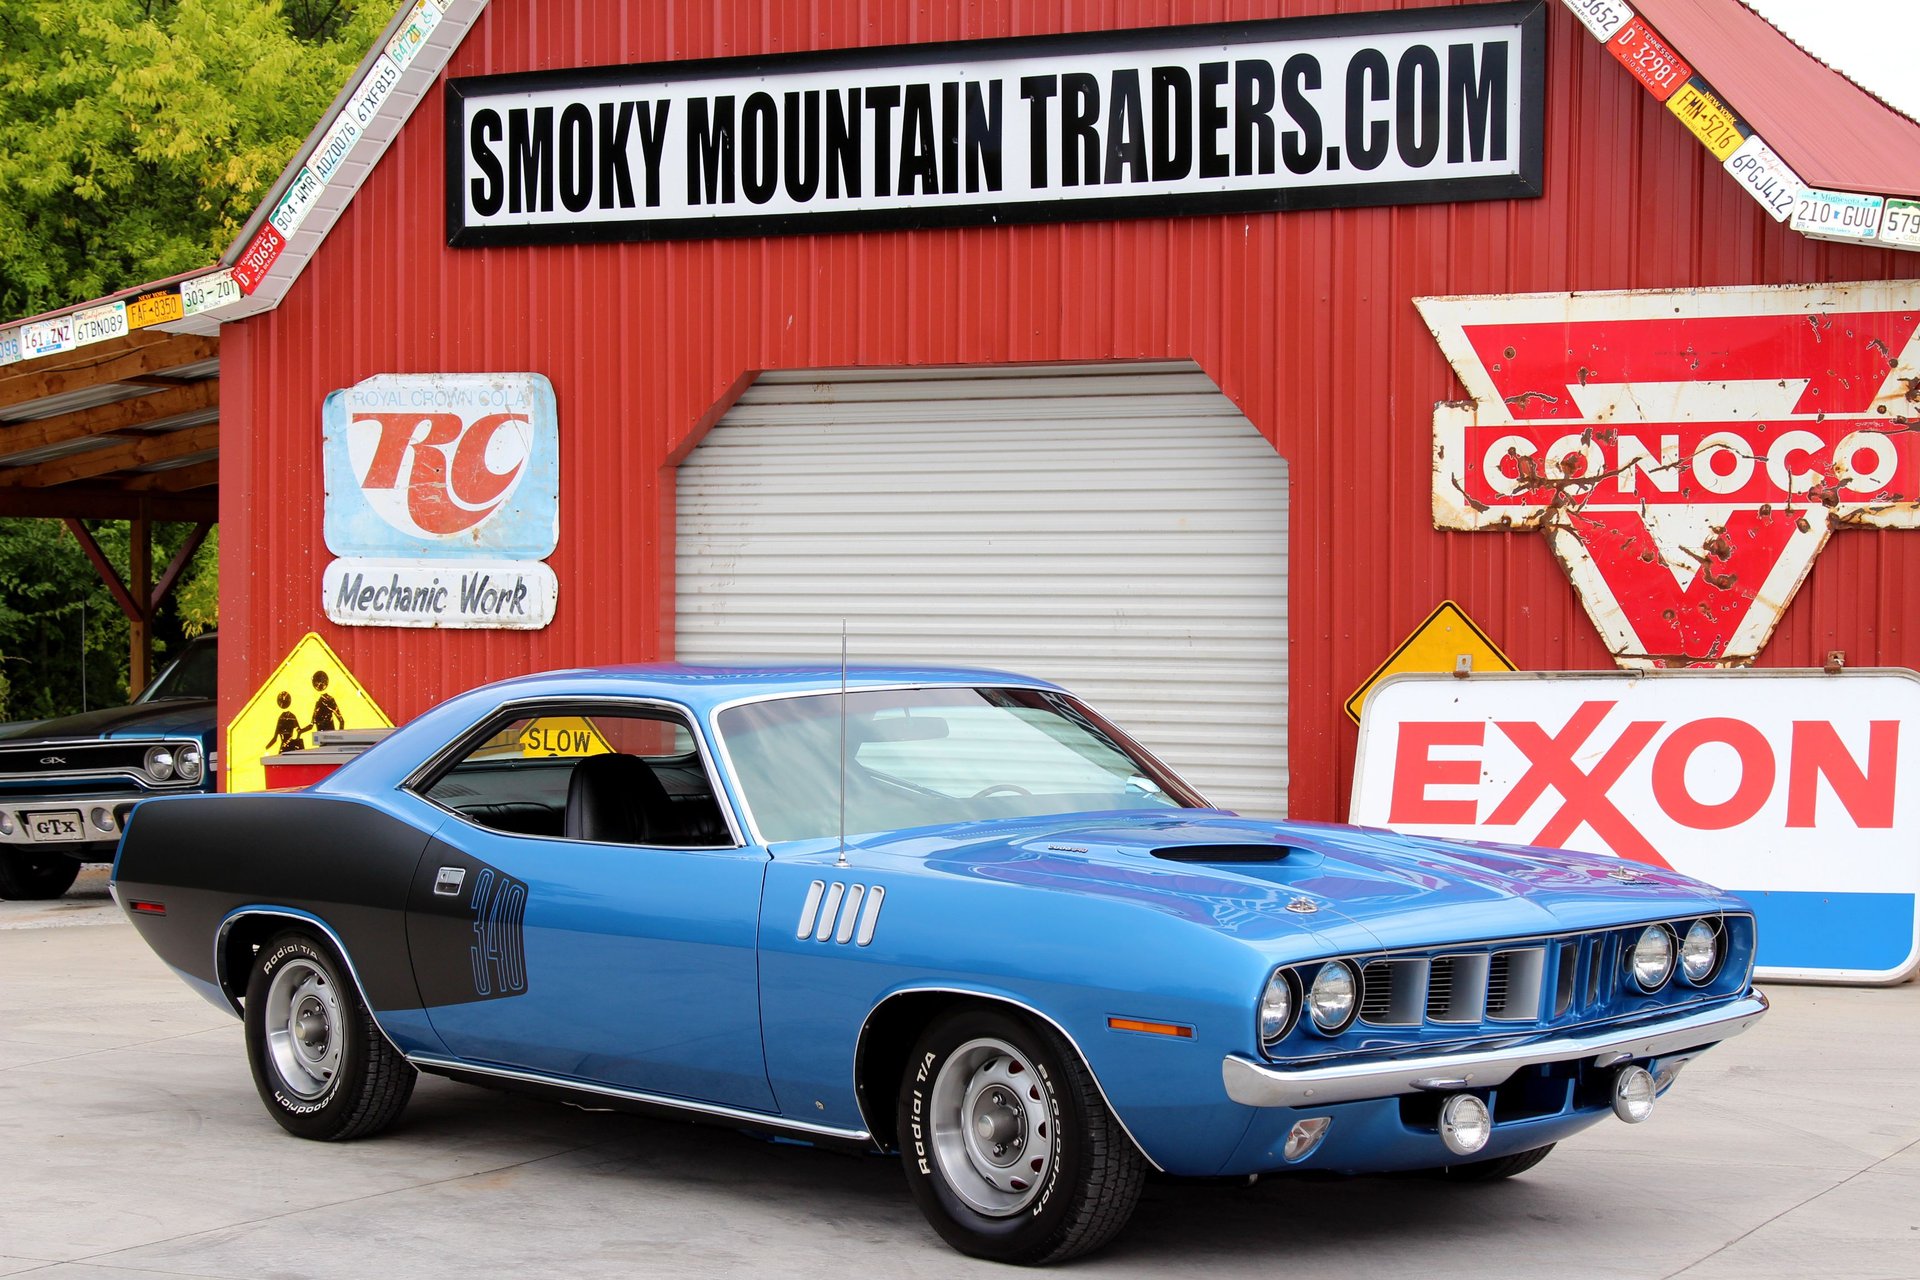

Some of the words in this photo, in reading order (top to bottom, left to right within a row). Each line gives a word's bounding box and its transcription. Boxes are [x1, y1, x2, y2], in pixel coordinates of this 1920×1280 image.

[354, 66, 396, 122] 6TXF815
[1703, 91, 1721, 109] NEW
[1717, 106, 1737, 125] YORK
[470, 98, 671, 217] SMOKY
[687, 78, 1002, 205] MOUNTAIN
[1020, 40, 1509, 190] TRADERS.COM
[1731, 149, 1795, 214] 6PGJ412
[1797, 200, 1831, 223] 210
[1842, 205, 1877, 228] GUU
[1887, 211, 1920, 234] 579
[25, 331, 44, 349] 161
[50, 325, 71, 343] ZNZ
[353, 390, 408, 407] ROYAL
[411, 390, 474, 407] CROWN
[478, 390, 526, 407] COLA
[352, 412, 529, 535] RC
[1482, 429, 1899, 495] CONOCO
[336, 572, 448, 613] Mechanic
[460, 570, 528, 616] Work
[528, 727, 591, 753] SLOW
[40, 756, 66, 764] GTX
[1387, 700, 1901, 871] EXXON
[36, 819, 76, 835] GTX
[263, 944, 299, 975] Radial
[300, 945, 318, 960] T/A
[916, 1051, 936, 1083] T/A
[911, 1089, 931, 1175] Radial
